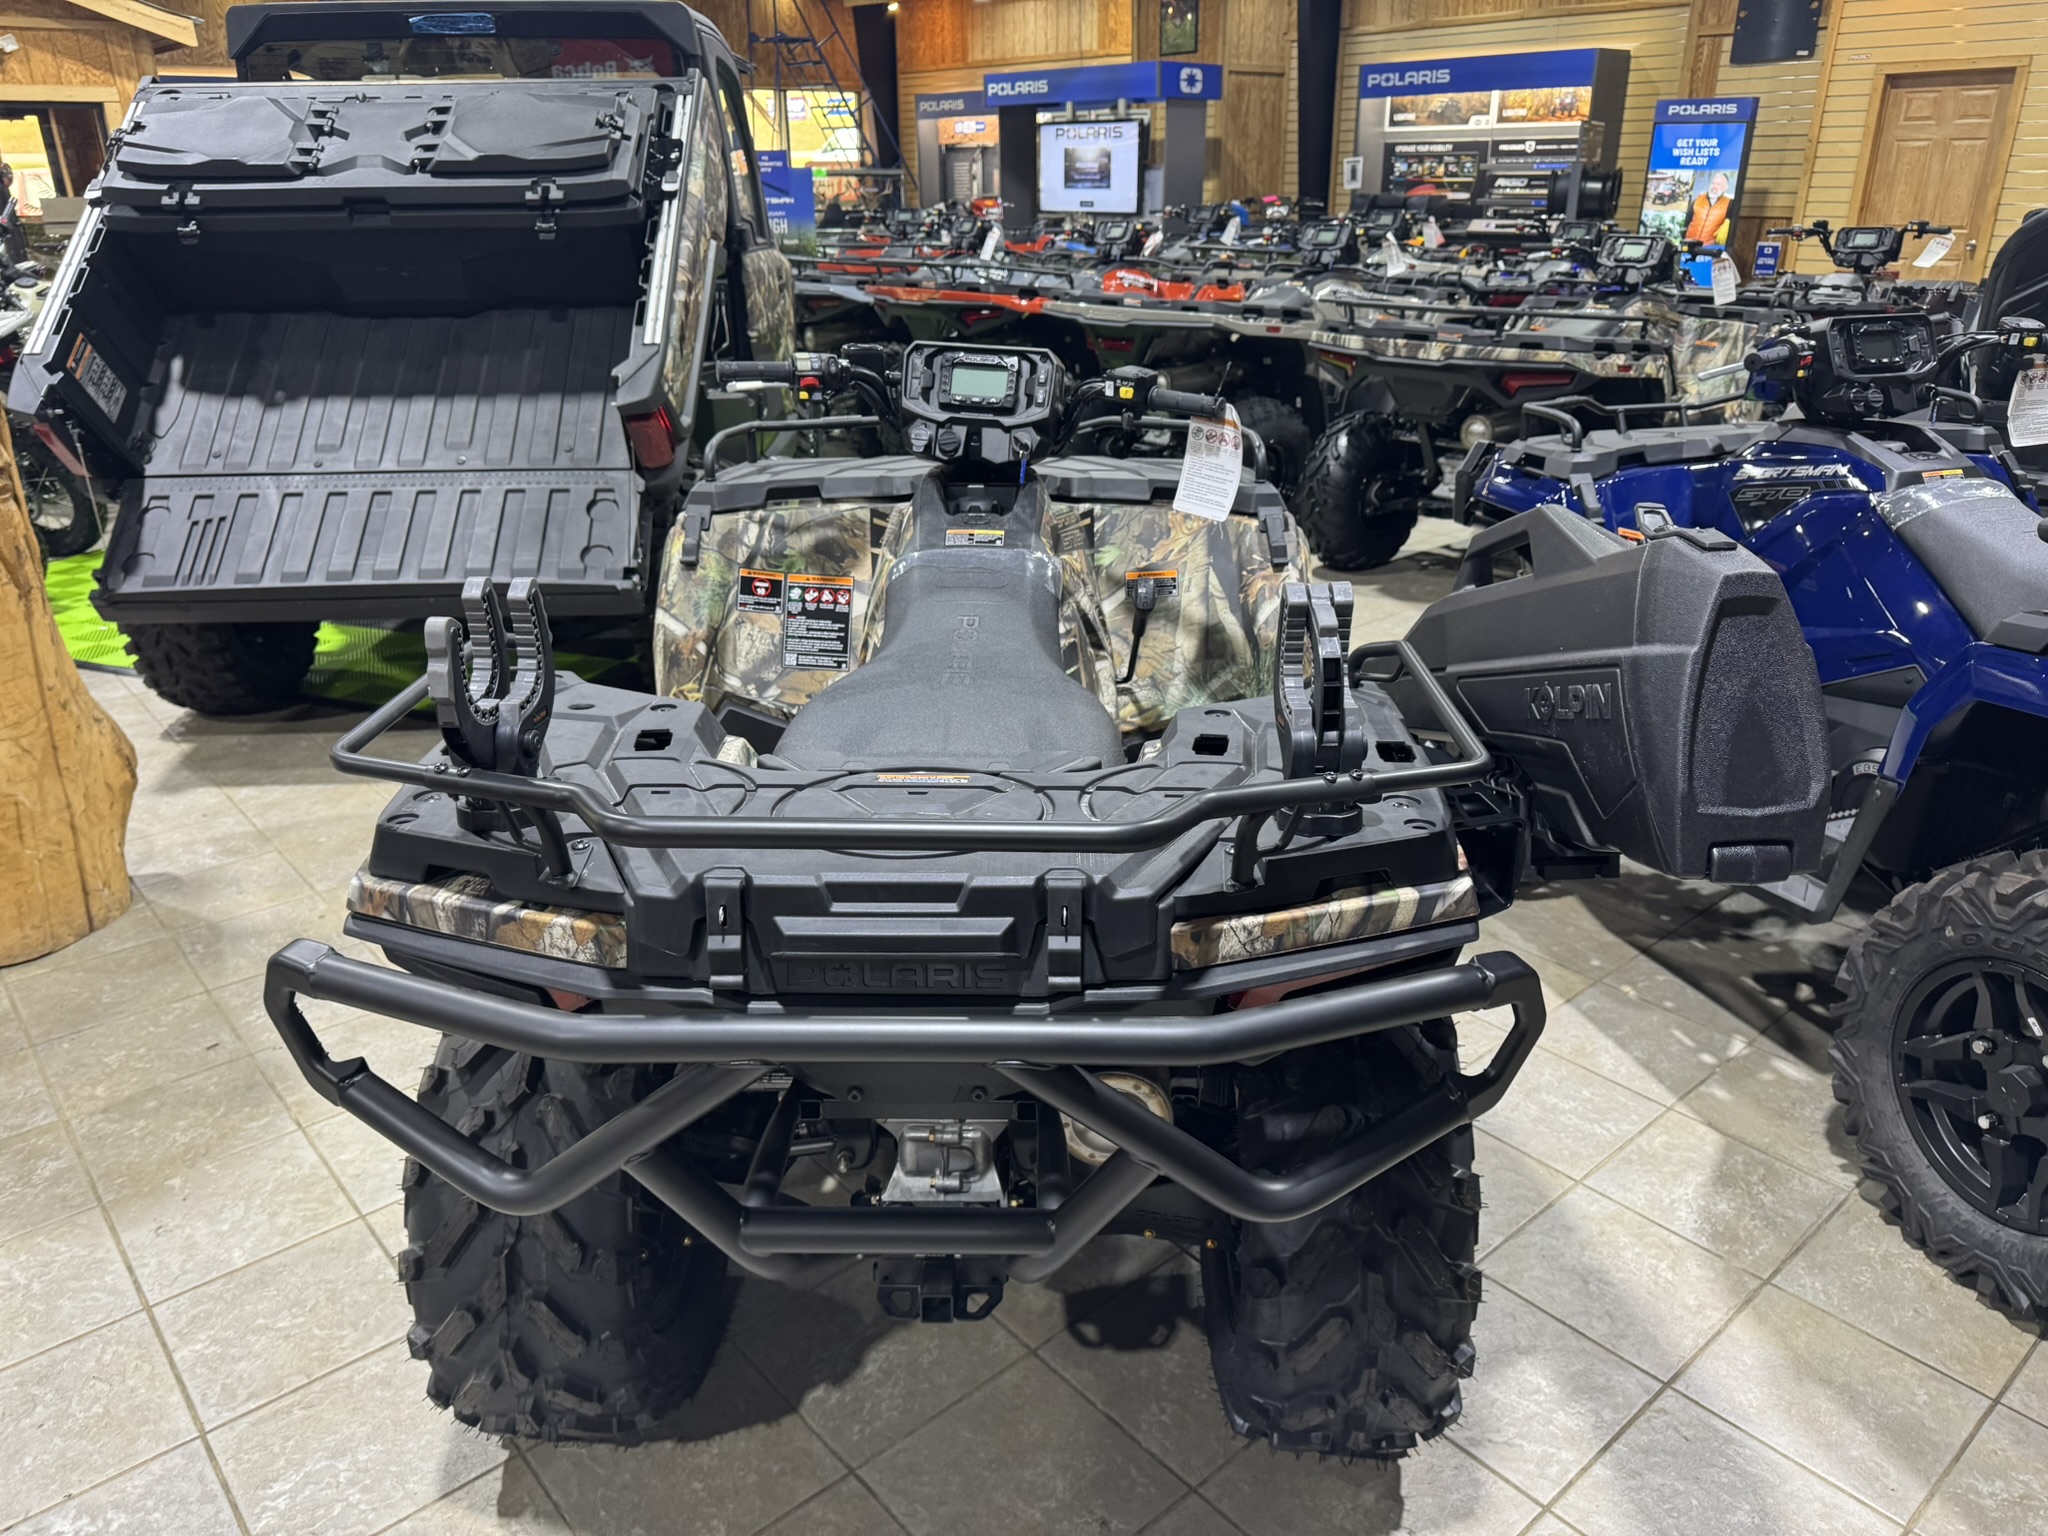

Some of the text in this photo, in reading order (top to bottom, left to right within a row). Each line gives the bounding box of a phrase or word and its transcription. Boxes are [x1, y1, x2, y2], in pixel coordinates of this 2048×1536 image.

[1368, 69, 1450, 88] POLARIS
[988, 80, 1048, 97] POLARIS
[919, 98, 964, 112] POLARIS
[1668, 104, 1738, 116] POLARIS
[1056, 126, 1123, 140] POLARIS
[1677, 138, 1718, 147] GET YOUR
[1673, 148, 1720, 156] WISH LISTS
[1680, 156, 1708, 166] READY
[1733, 463, 1851, 480] SPORTSMAN
[1735, 486, 1812, 502] 570
[1524, 682, 1612, 723] KOLPIN
[786, 962, 1008, 989] POLARIS
